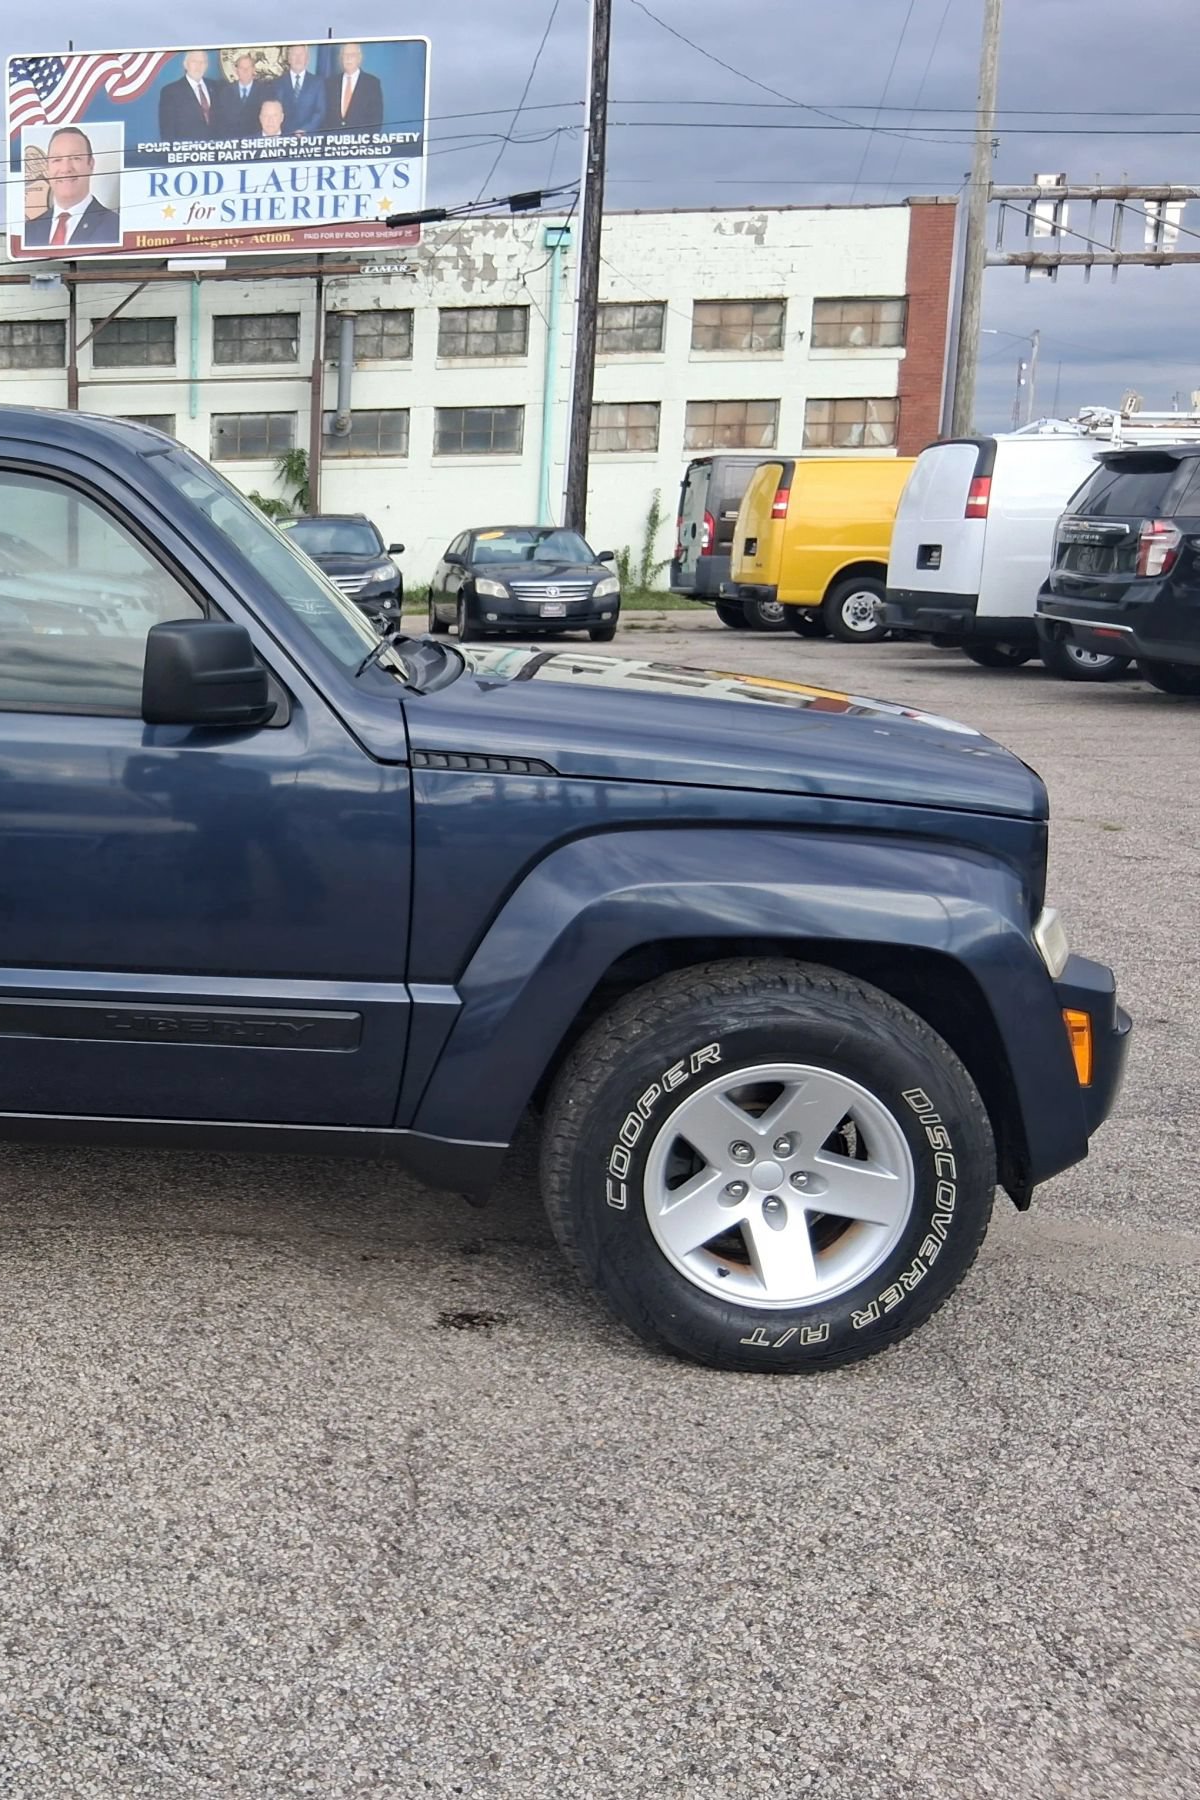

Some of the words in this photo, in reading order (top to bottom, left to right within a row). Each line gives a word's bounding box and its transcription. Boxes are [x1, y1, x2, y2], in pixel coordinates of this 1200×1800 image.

[137, 142, 170, 153] FOUR
[173, 140, 238, 152] DEMOCRAT
[240, 136, 298, 149] SHERIFFS
[301, 136, 324, 146] PUT
[327, 134, 370, 145] PUBLIC
[373, 132, 420, 143] SAFETY
[168, 152, 215, 163] BEFORE
[218, 150, 256, 161] PARTY
[260, 148, 286, 158] AND
[290, 147, 321, 158] HAVE
[324, 146, 391, 156] ENDORSED
[148, 171, 224, 197] ROD
[238, 162, 410, 194] LAUREYS
[183, 201, 215, 224] for
[220, 194, 372, 222] SHERIFF
[320, 232, 334, 240] FOR
[364, 265, 408, 274] LAMAR
[606, 1042, 722, 1210] COOPER
[851, 1088, 956, 1330] DISCOVERER
[739, 1322, 830, 1348] A/T
